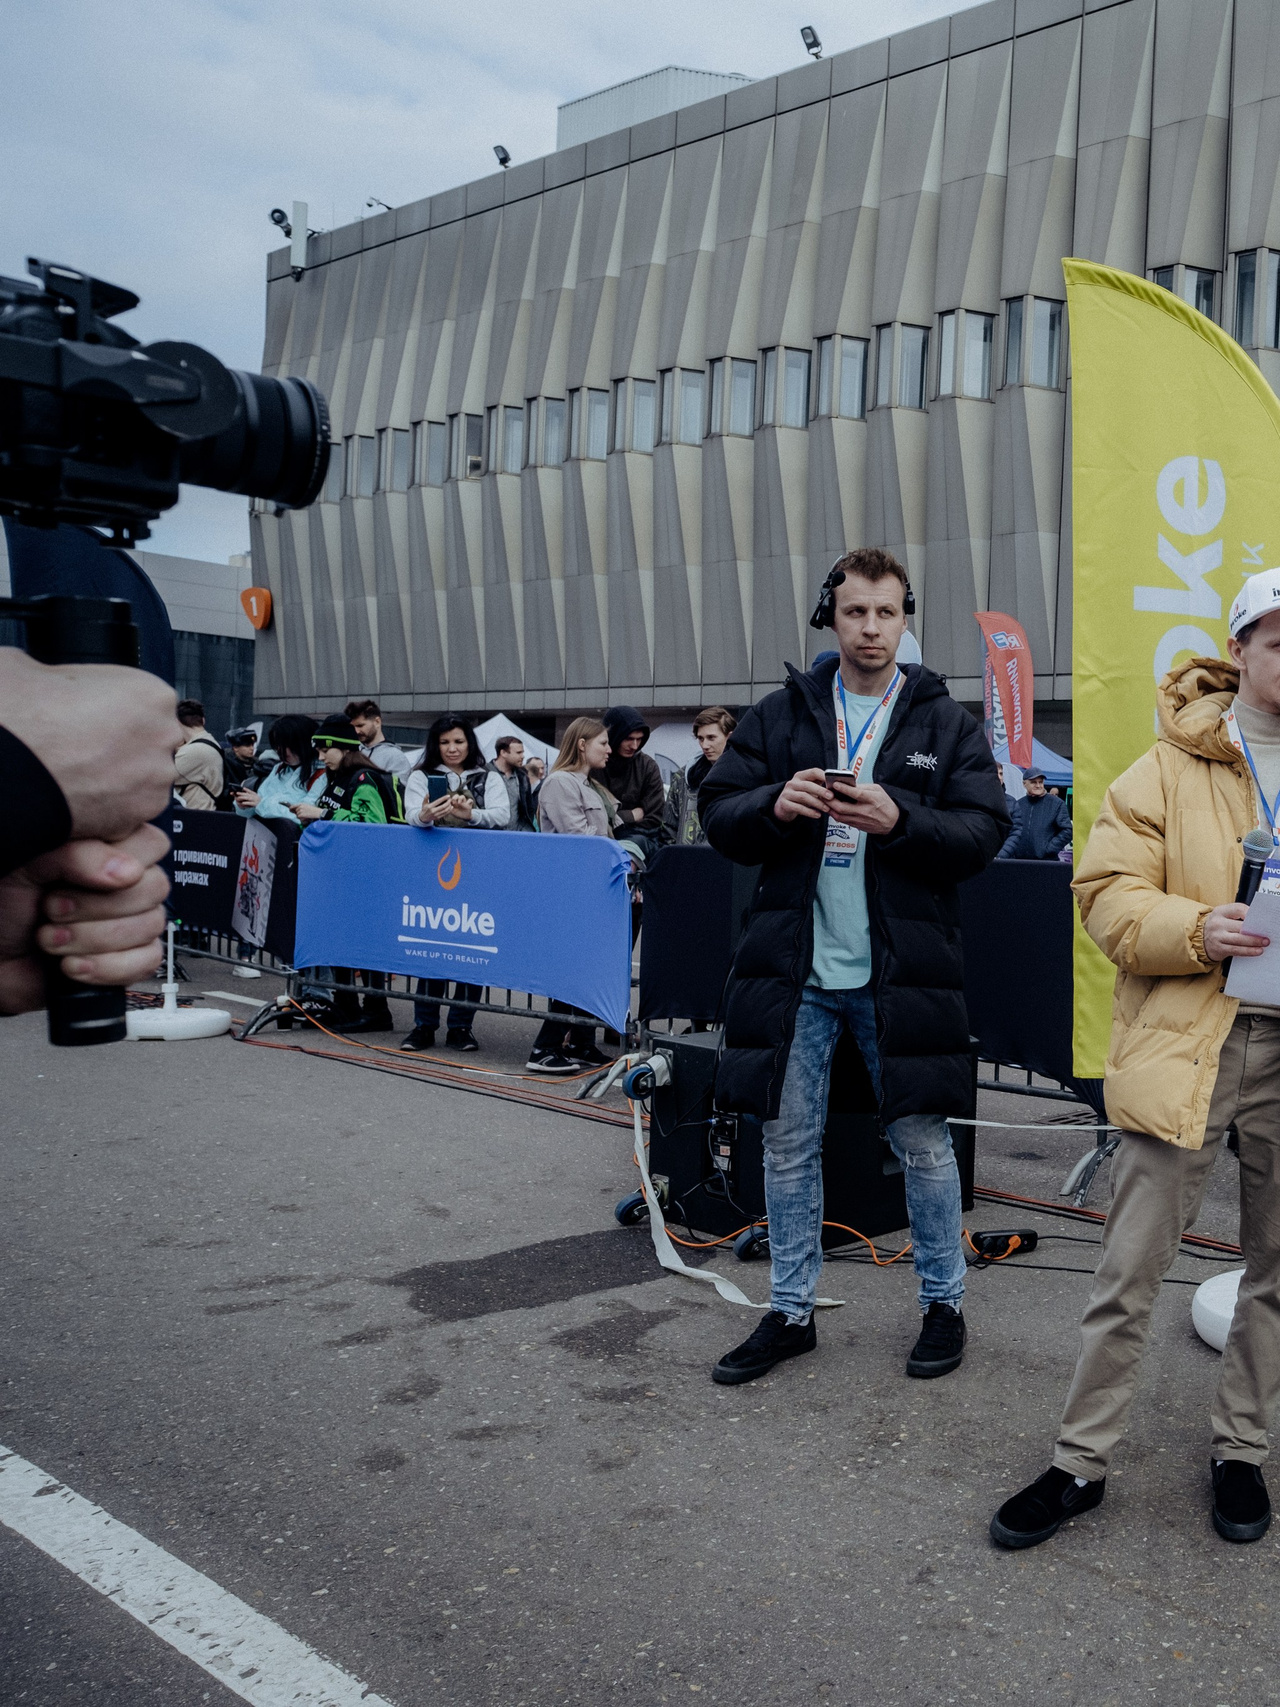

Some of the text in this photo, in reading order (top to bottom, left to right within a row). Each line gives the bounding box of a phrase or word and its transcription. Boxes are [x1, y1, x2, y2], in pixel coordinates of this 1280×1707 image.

[250, 596, 258, 617] 1
[838, 719, 846, 750] MOTO
[402, 895, 495, 936] invoke
[405, 948, 428, 957] WAKE
[442, 952, 454, 961] TO
[455, 954, 490, 966] REALITY
